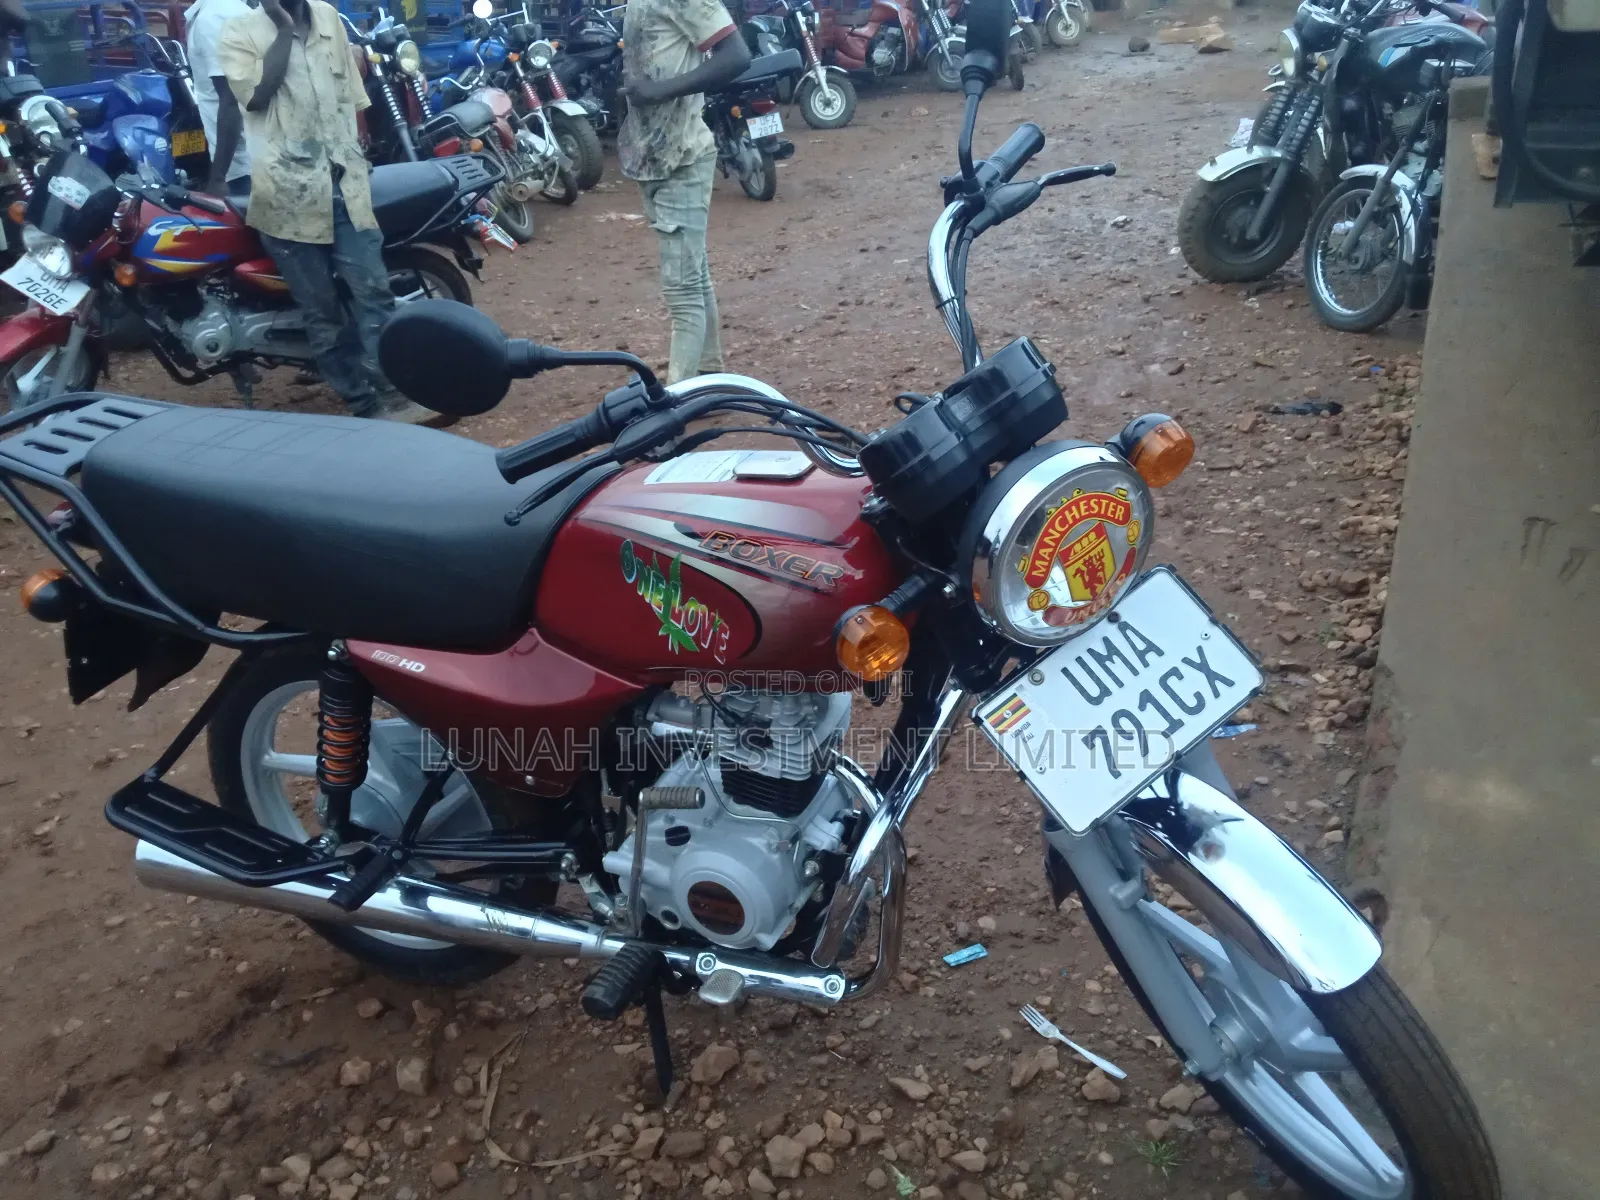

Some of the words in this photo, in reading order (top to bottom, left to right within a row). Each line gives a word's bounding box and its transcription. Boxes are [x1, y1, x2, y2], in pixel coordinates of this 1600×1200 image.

[700, 530, 845, 587] BOXER
[1032, 498, 1125, 578] MANCHESTER
[398, 658, 426, 673] HD
[1061, 621, 1165, 706] UMA
[1081, 645, 1236, 780] 791CX
